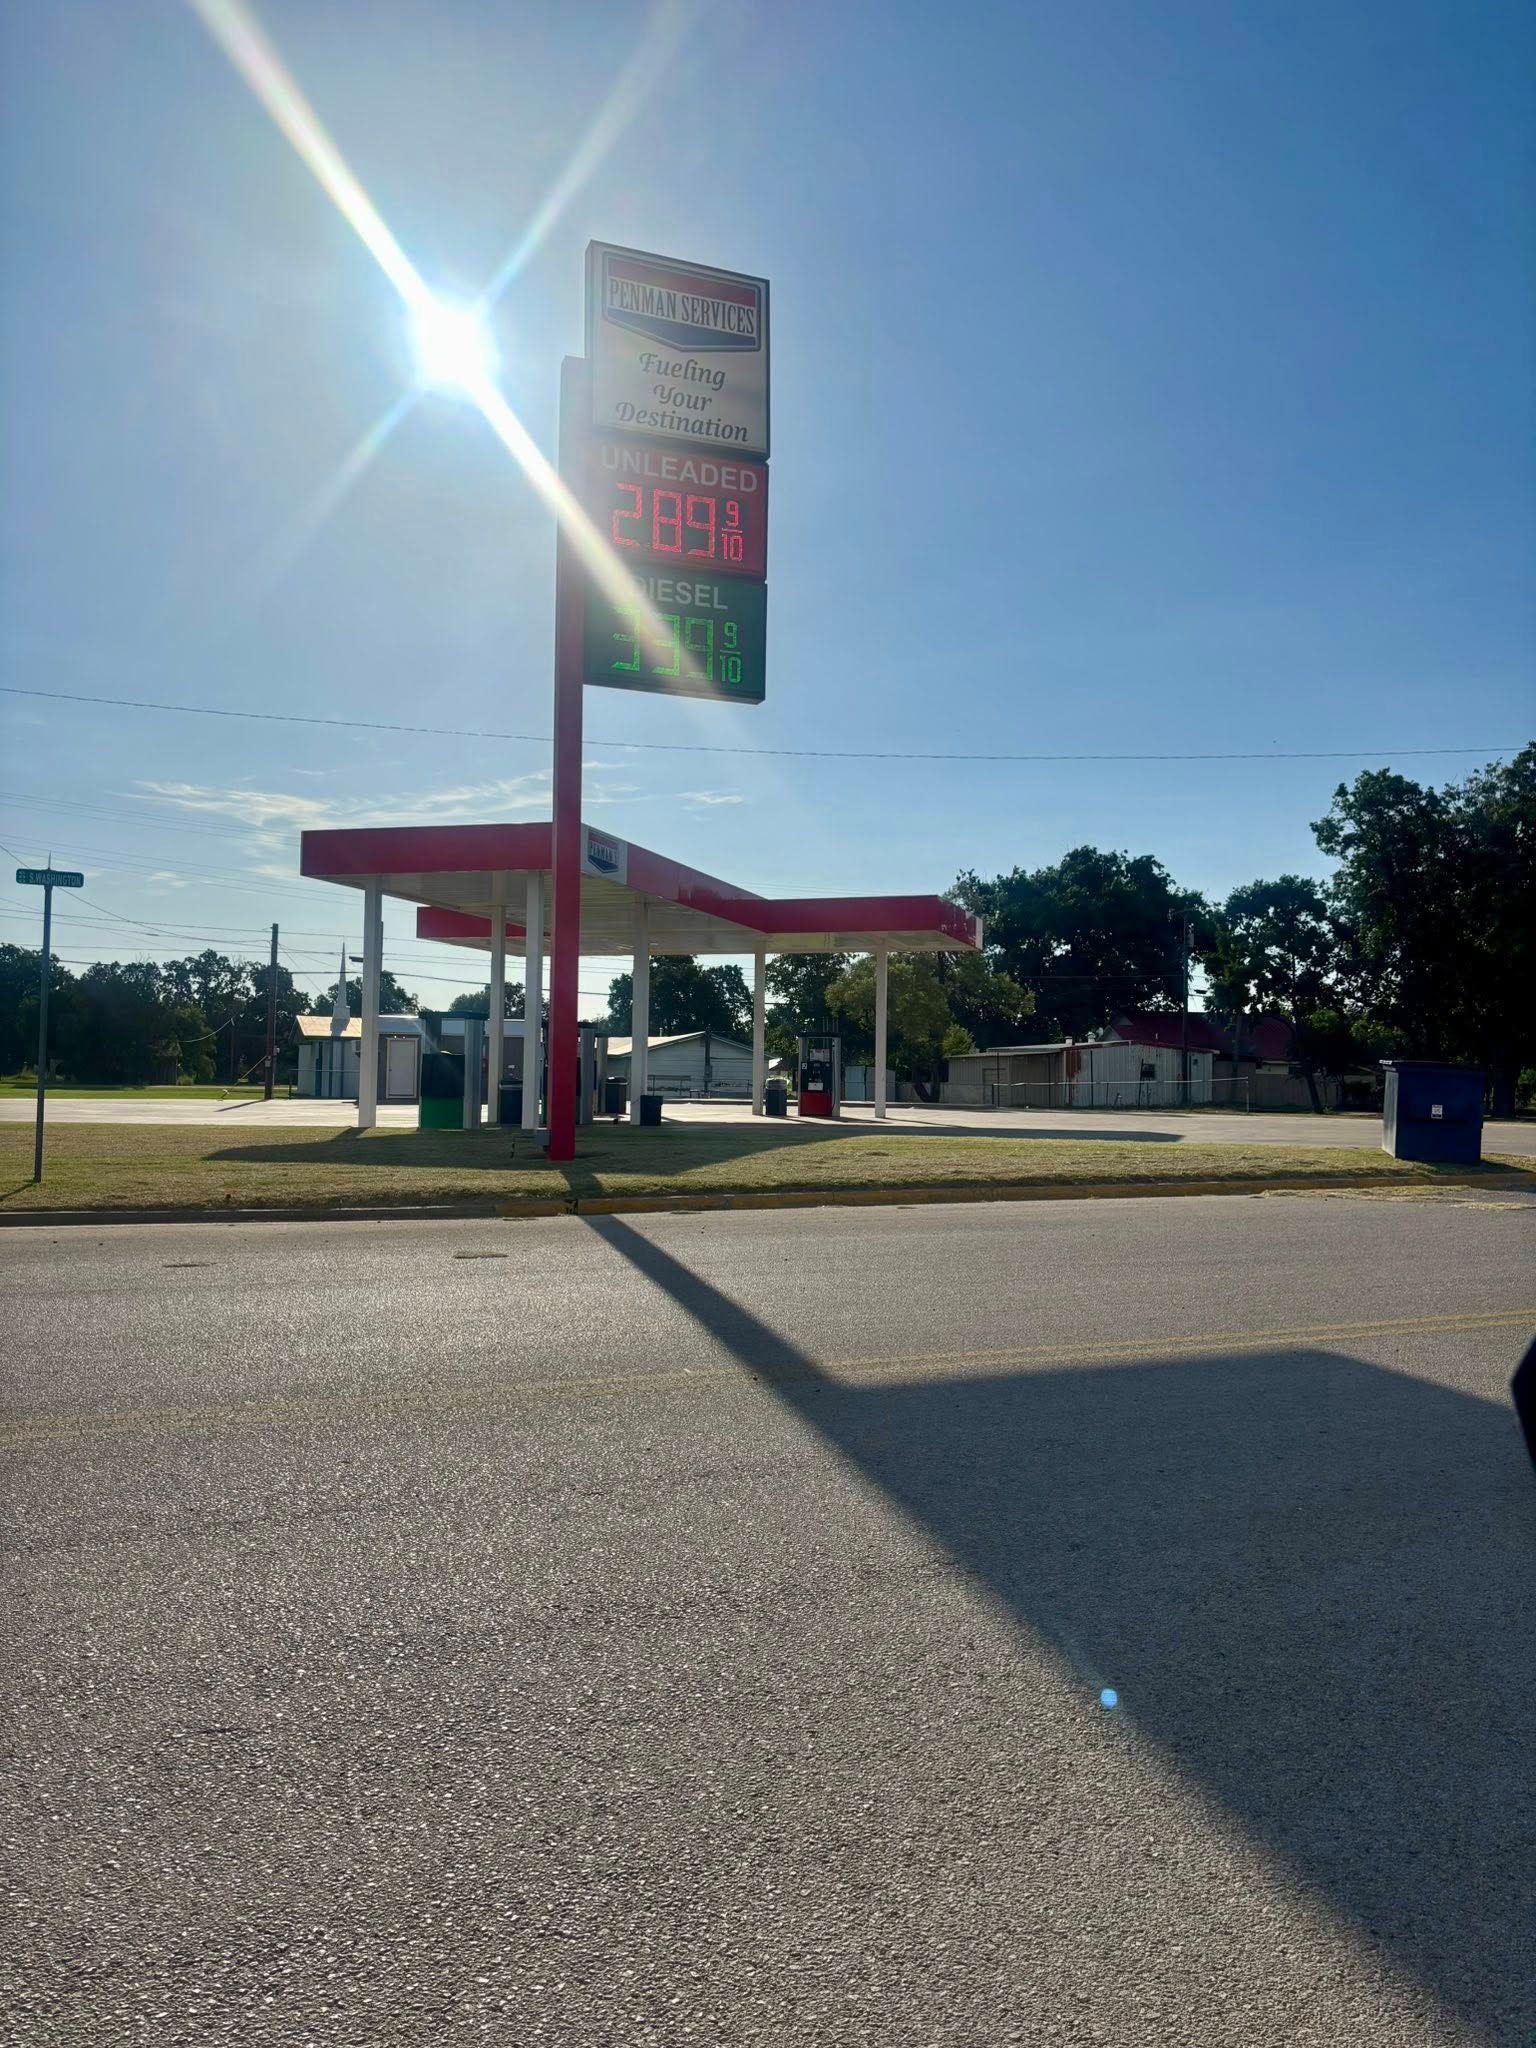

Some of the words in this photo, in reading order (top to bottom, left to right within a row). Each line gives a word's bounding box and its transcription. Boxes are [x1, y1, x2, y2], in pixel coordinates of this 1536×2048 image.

[609, 278, 678, 320] PENMAN
[681, 296, 755, 335] SERVICES
[639, 352, 726, 392] Fueling
[653, 384, 713, 412] Your
[615, 401, 750, 443] Destination
[600, 444, 758, 493] UNLEADED
[612, 482, 715, 558] 289
[631, 576, 728, 611] DIESEL
[35, 873, 81, 887] WASHINGTON
